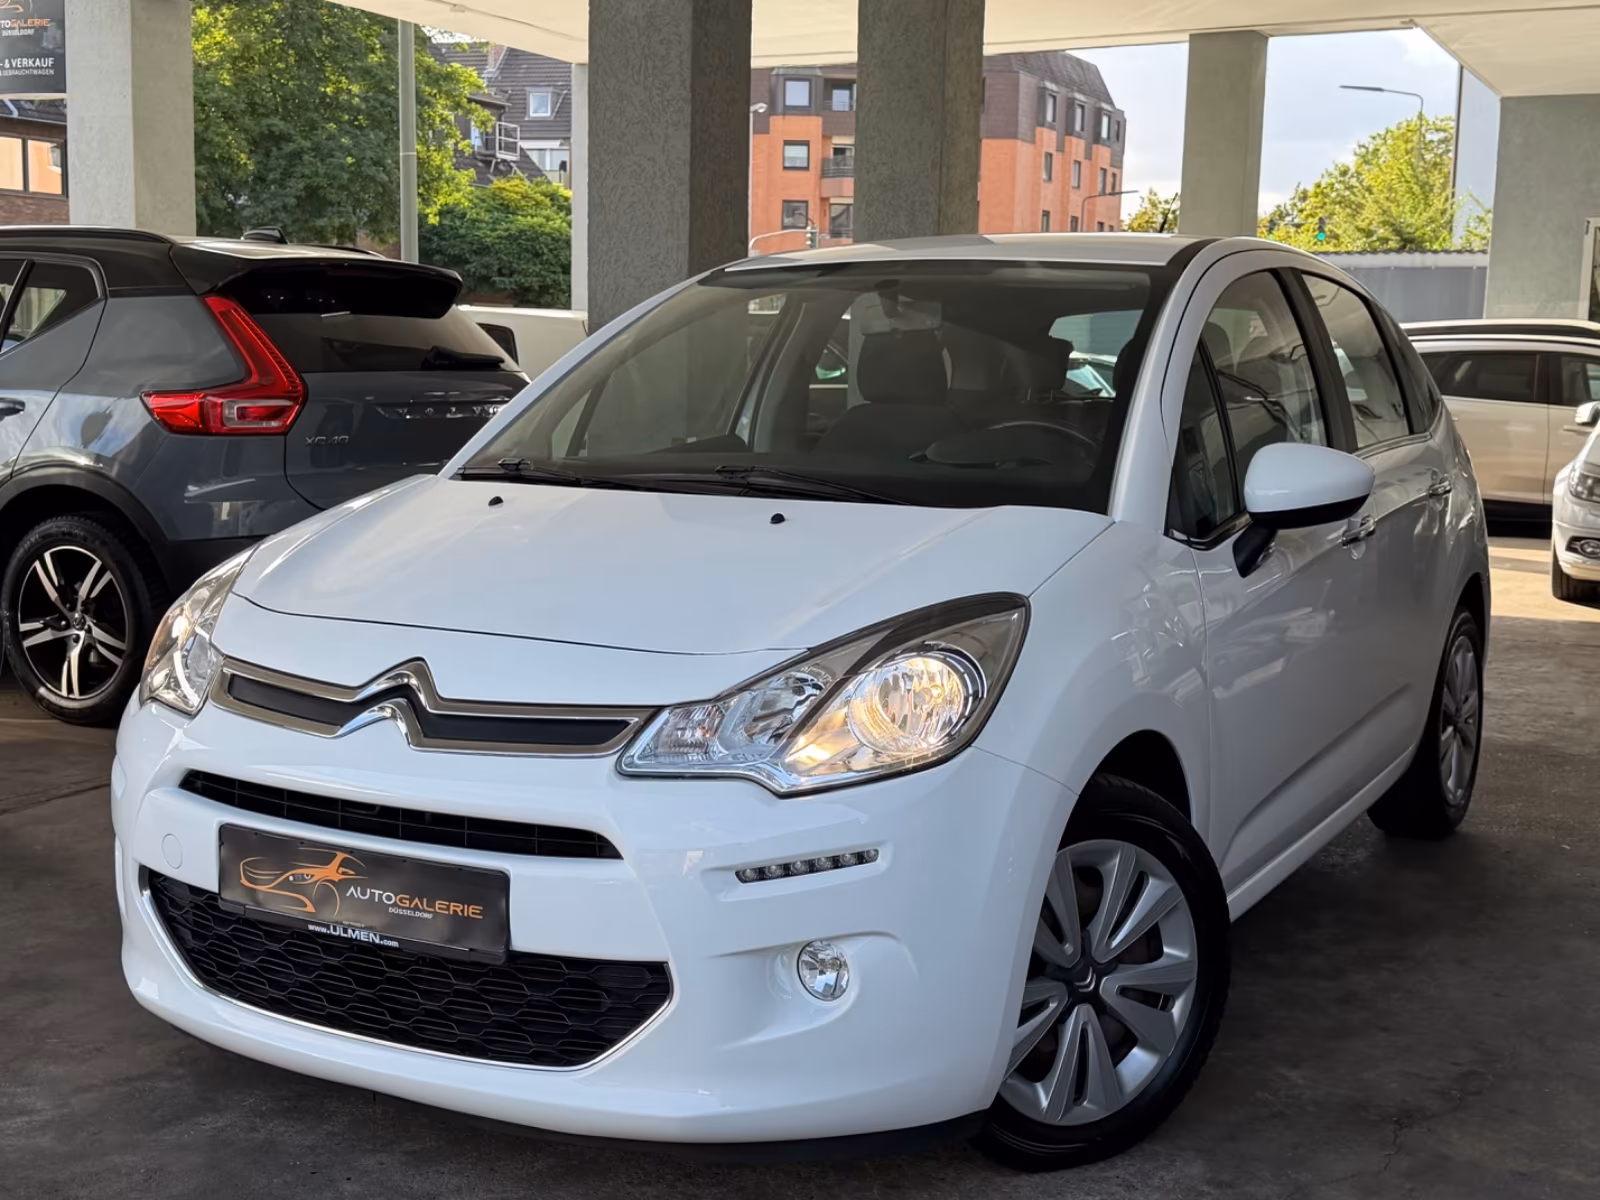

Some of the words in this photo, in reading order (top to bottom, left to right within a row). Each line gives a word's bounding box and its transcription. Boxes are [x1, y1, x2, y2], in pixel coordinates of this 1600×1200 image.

[11, 57, 54, 68] VERKAUF
[346, 885, 483, 919] AUTOGALERIE
[388, 906, 433, 919] DÜSSELDORF
[307, 923, 399, 948] www.ULMEN.com
